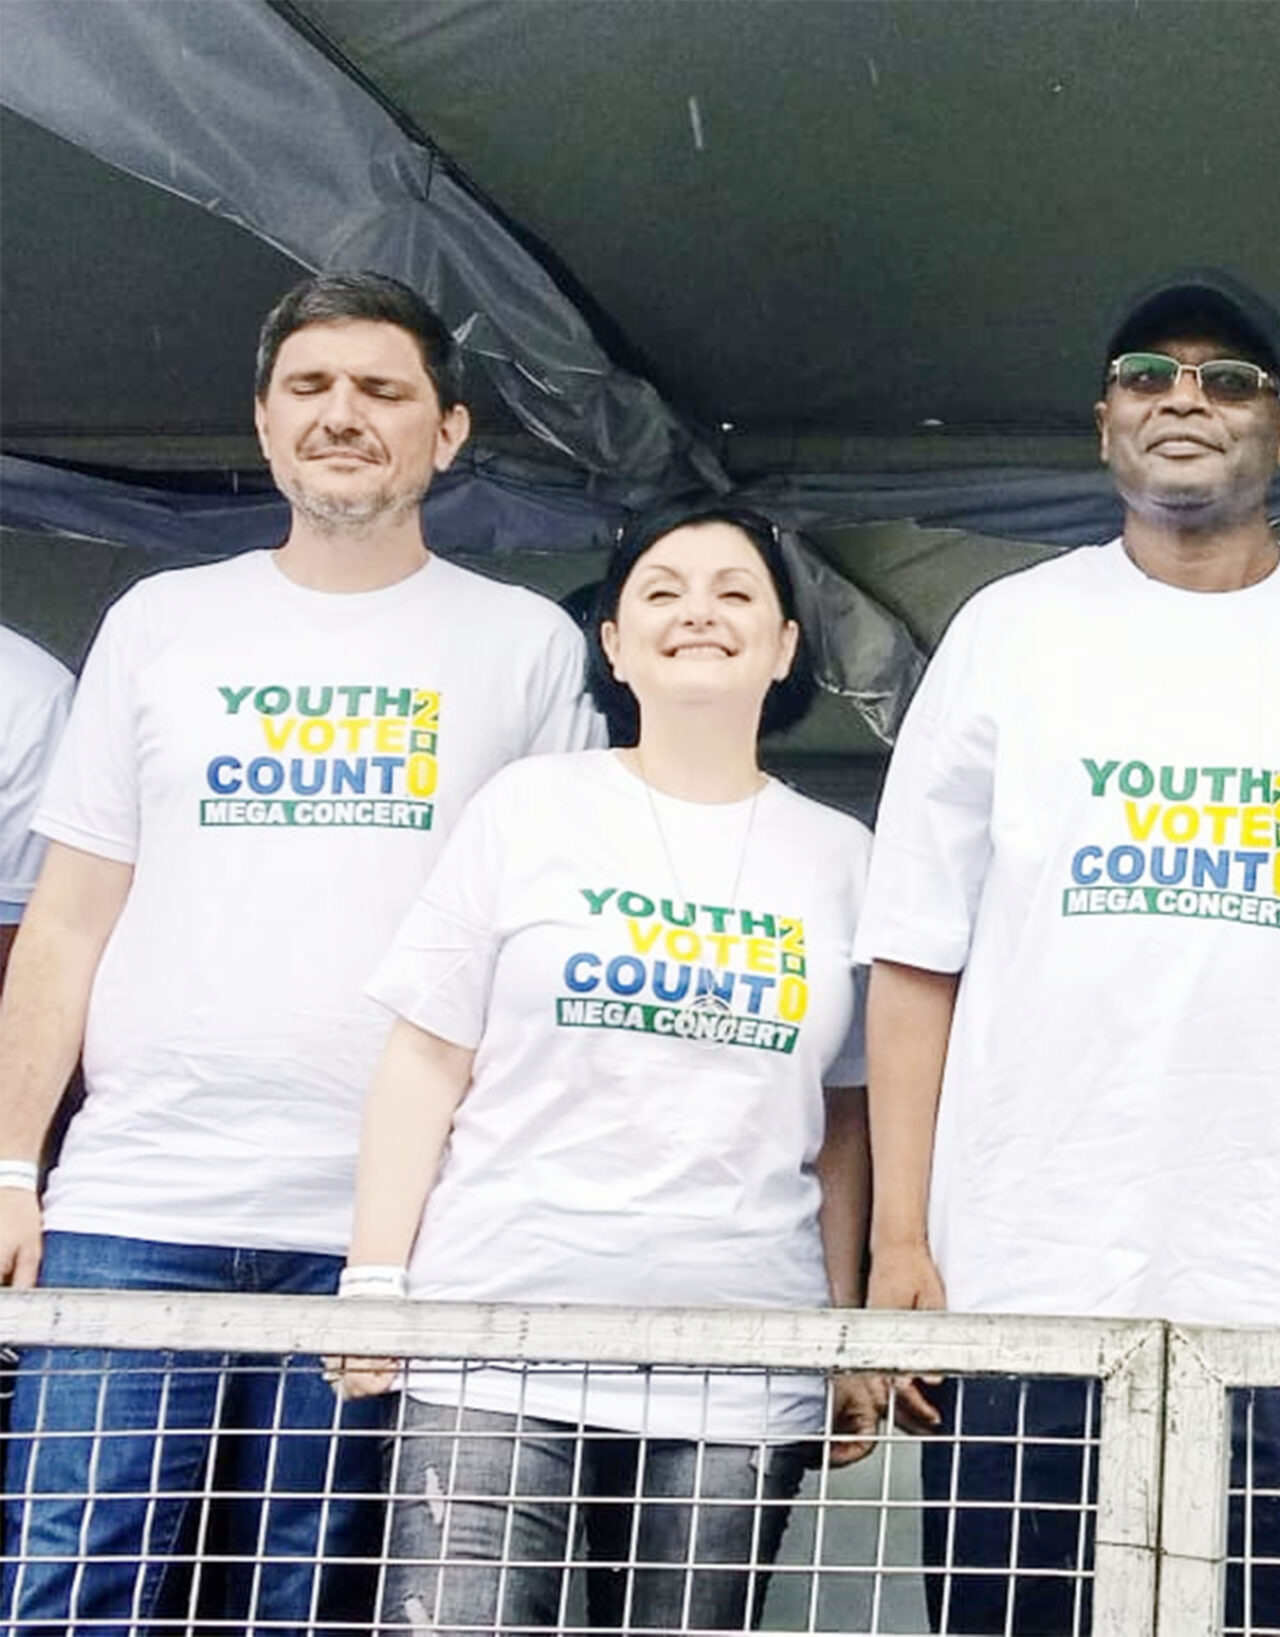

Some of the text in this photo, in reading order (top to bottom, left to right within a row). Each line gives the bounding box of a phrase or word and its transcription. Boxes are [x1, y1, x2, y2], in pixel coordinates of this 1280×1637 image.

[217, 685, 412, 717] YOUTH
[261, 716, 407, 754] VOTE
[206, 755, 405, 795] COUNT
[1081, 757, 1272, 803] YOUTH
[204, 801, 428, 827] MEGA CONCERT
[1124, 800, 1272, 848] VOTE
[1070, 844, 1270, 892] COUNT
[579, 887, 777, 937] YOUTH
[1067, 888, 1149, 914] MEGA
[625, 917, 777, 972] VOTE
[563, 952, 776, 1014] COUNT
[562, 999, 645, 1029] MEGA
